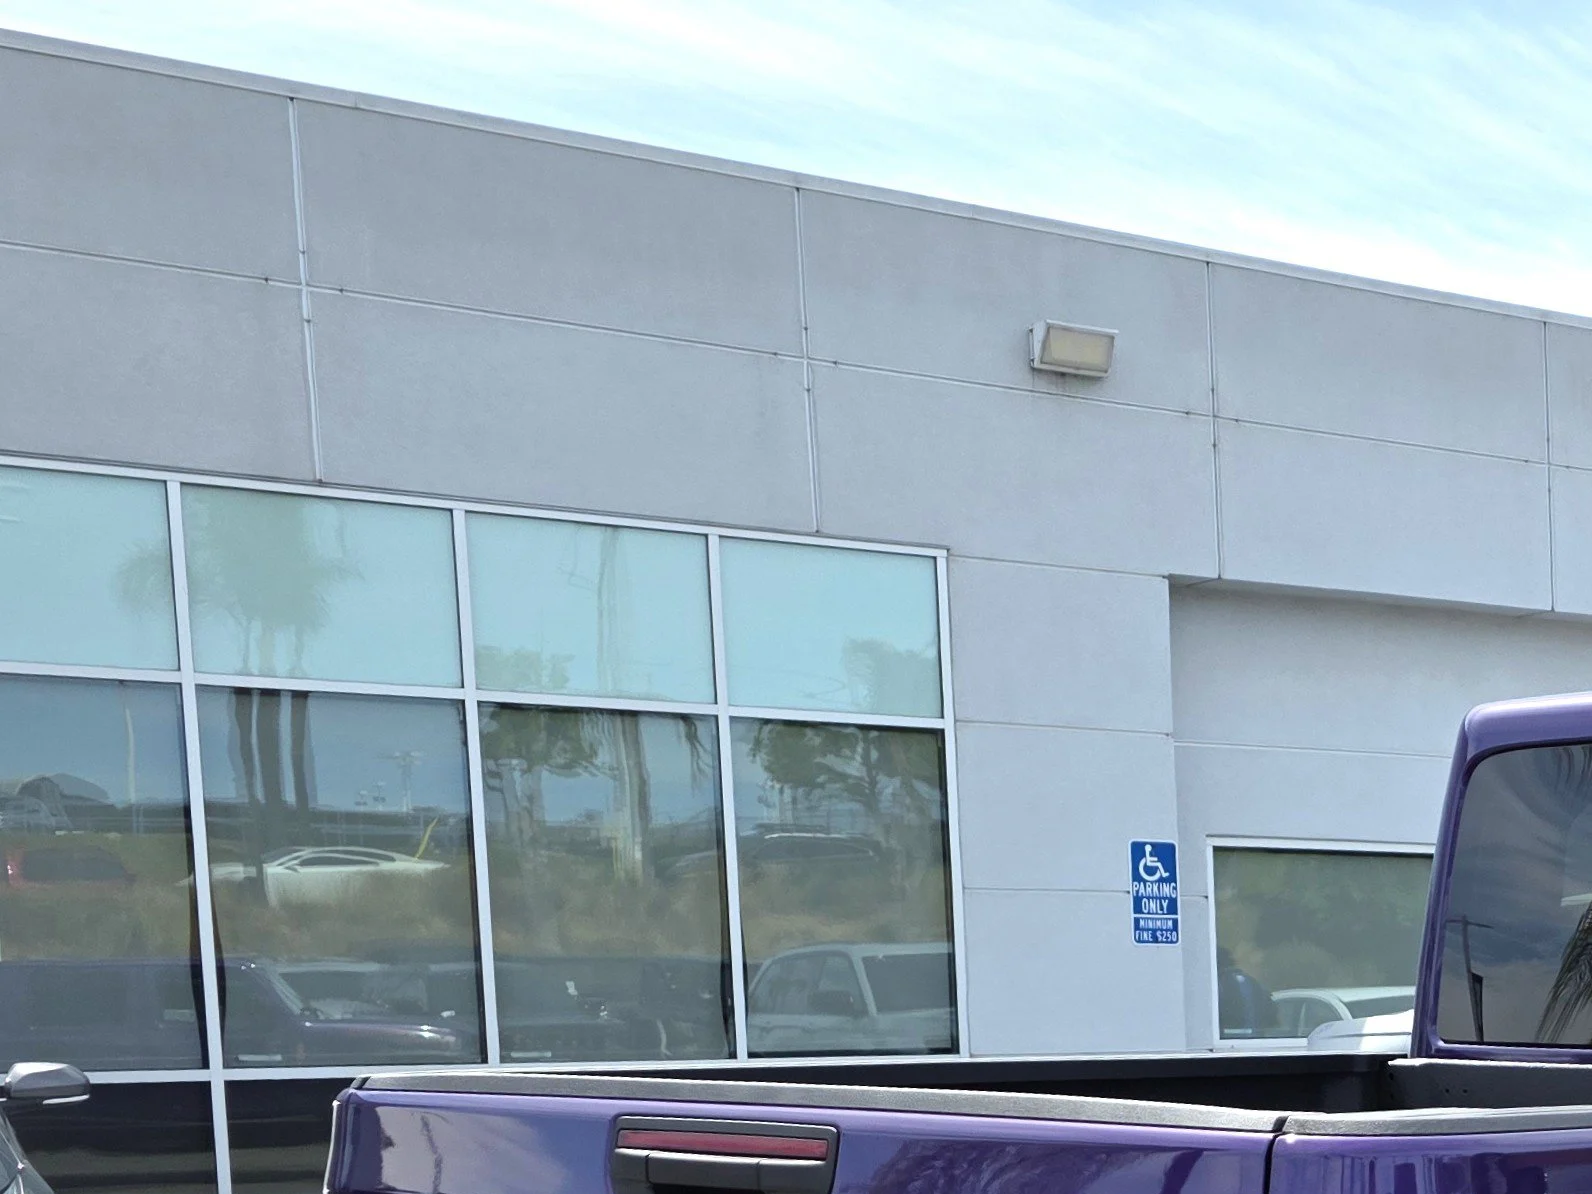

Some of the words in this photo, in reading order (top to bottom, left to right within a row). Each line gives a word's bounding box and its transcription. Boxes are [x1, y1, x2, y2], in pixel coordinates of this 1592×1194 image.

[1132, 881, 1177, 898] PARKING
[1141, 898, 1168, 914] ONLY
[1139, 918, 1173, 930] MINIMUM
[1135, 930, 1153, 941] FINE
[1156, 930, 1177, 942] $250
